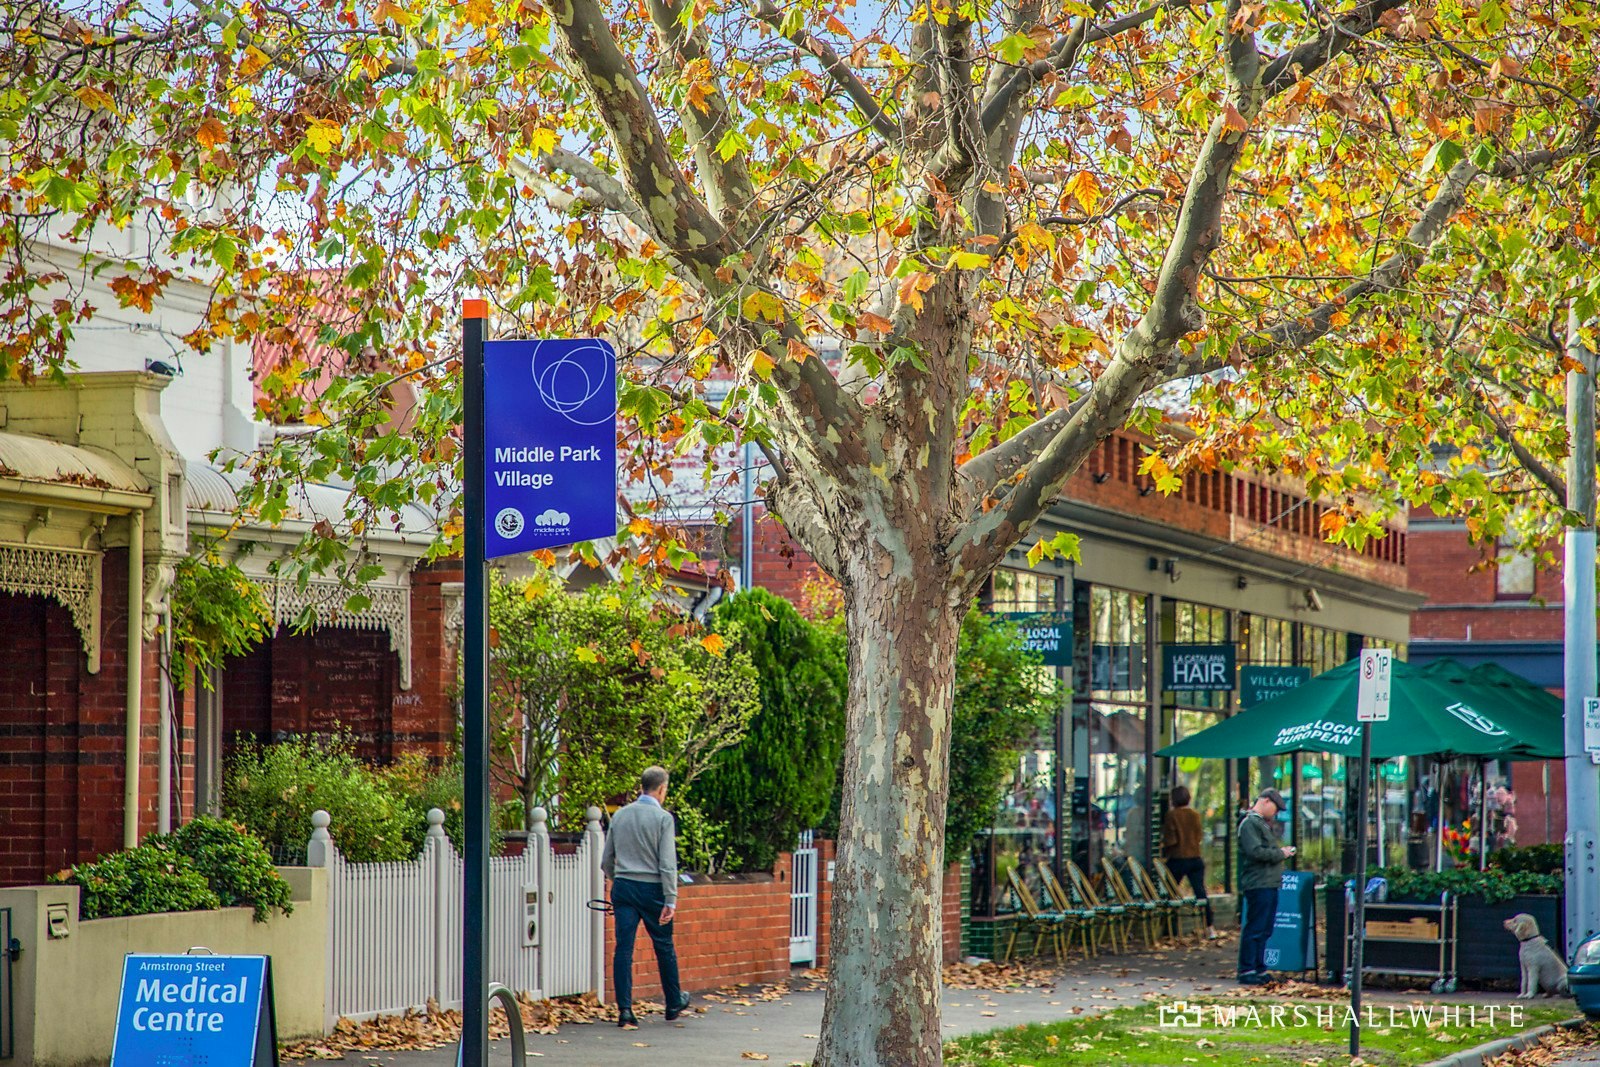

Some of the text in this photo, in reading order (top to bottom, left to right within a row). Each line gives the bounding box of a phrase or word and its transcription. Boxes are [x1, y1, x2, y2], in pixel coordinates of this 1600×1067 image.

[495, 445, 601, 463] Middle Park
[494, 470, 553, 489] Village
[1026, 627, 1062, 639] LOCAL
[1007, 640, 1059, 652] OPEAN
[1379, 656, 1388, 672] 1P
[1173, 663, 1226, 683] HAIR
[1250, 675, 1302, 688] VILLAGE
[1255, 690, 1288, 701] STO
[1588, 700, 1599, 713] 1P
[1278, 719, 1362, 737] NEDS LOCAL
[1273, 729, 1354, 746] EUROPEAN
[140, 962, 226, 973] Armstrong Street
[135, 976, 248, 1004] Medical
[132, 1007, 224, 1032] Centre
